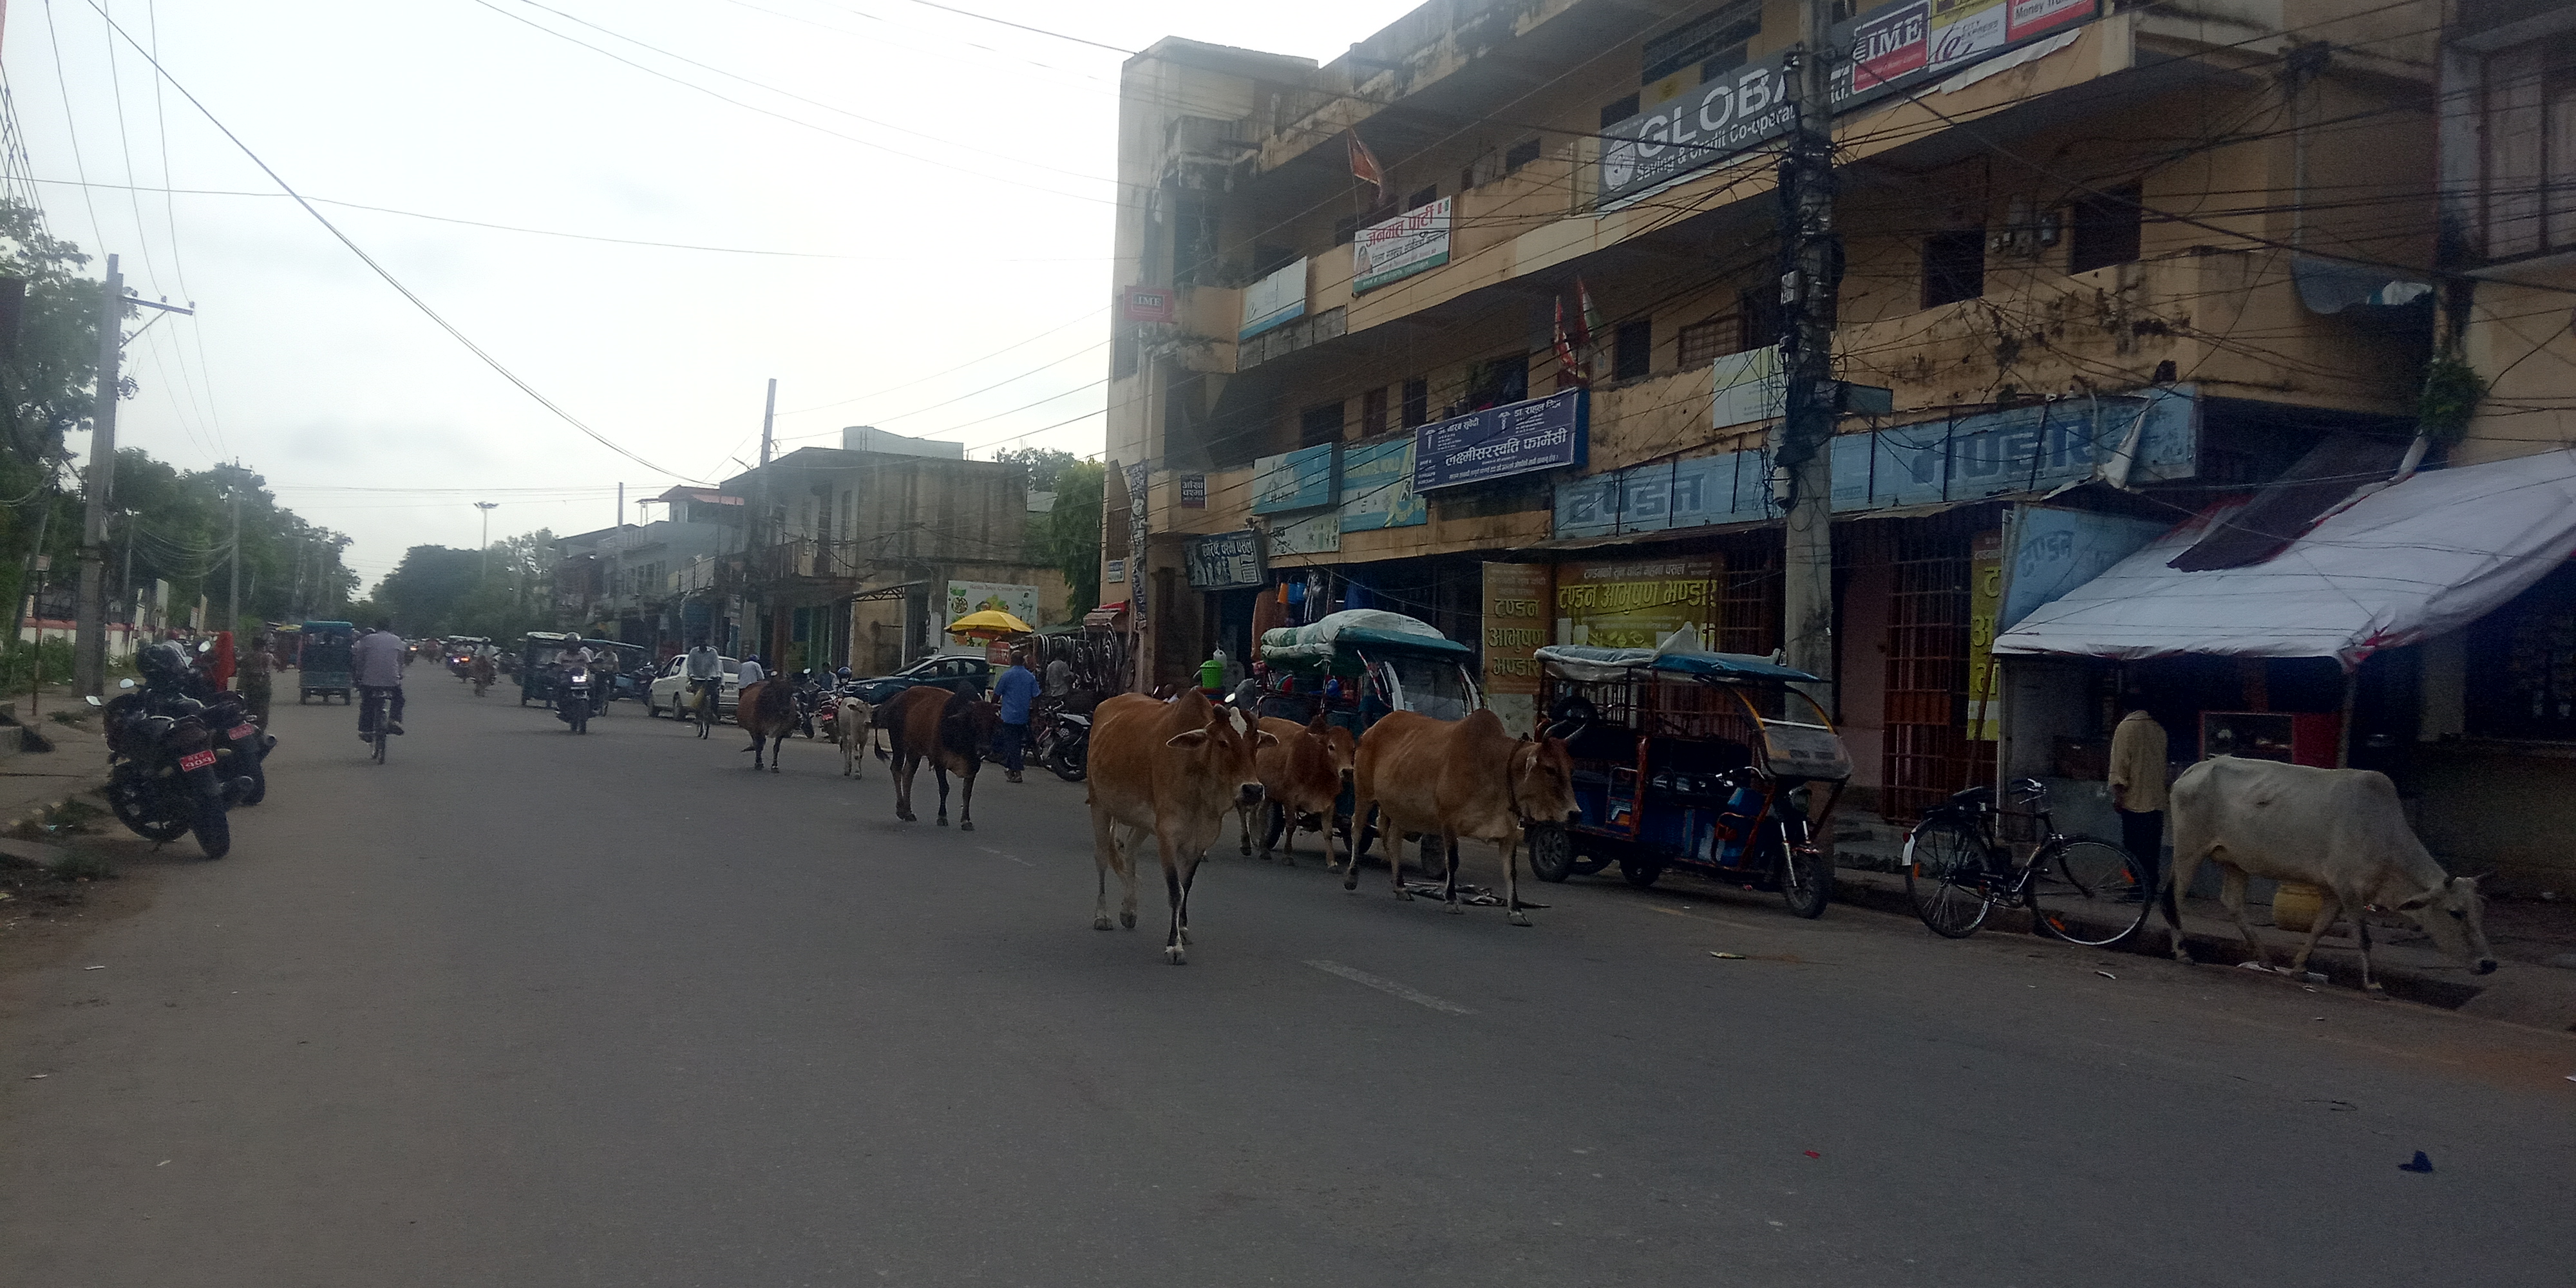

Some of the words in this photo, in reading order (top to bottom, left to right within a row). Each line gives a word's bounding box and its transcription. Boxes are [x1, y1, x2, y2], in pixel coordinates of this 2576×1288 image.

[2014, 2, 2045, 19] Money
[1866, 13, 1924, 63] IME
[1636, 155, 1674, 182] Saving
[1677, 147, 1687, 165] &
[1689, 129, 1727, 160] Credit
[1729, 104, 1796, 144] Co-operat
[1494, 598, 1540, 618] टण्डन
